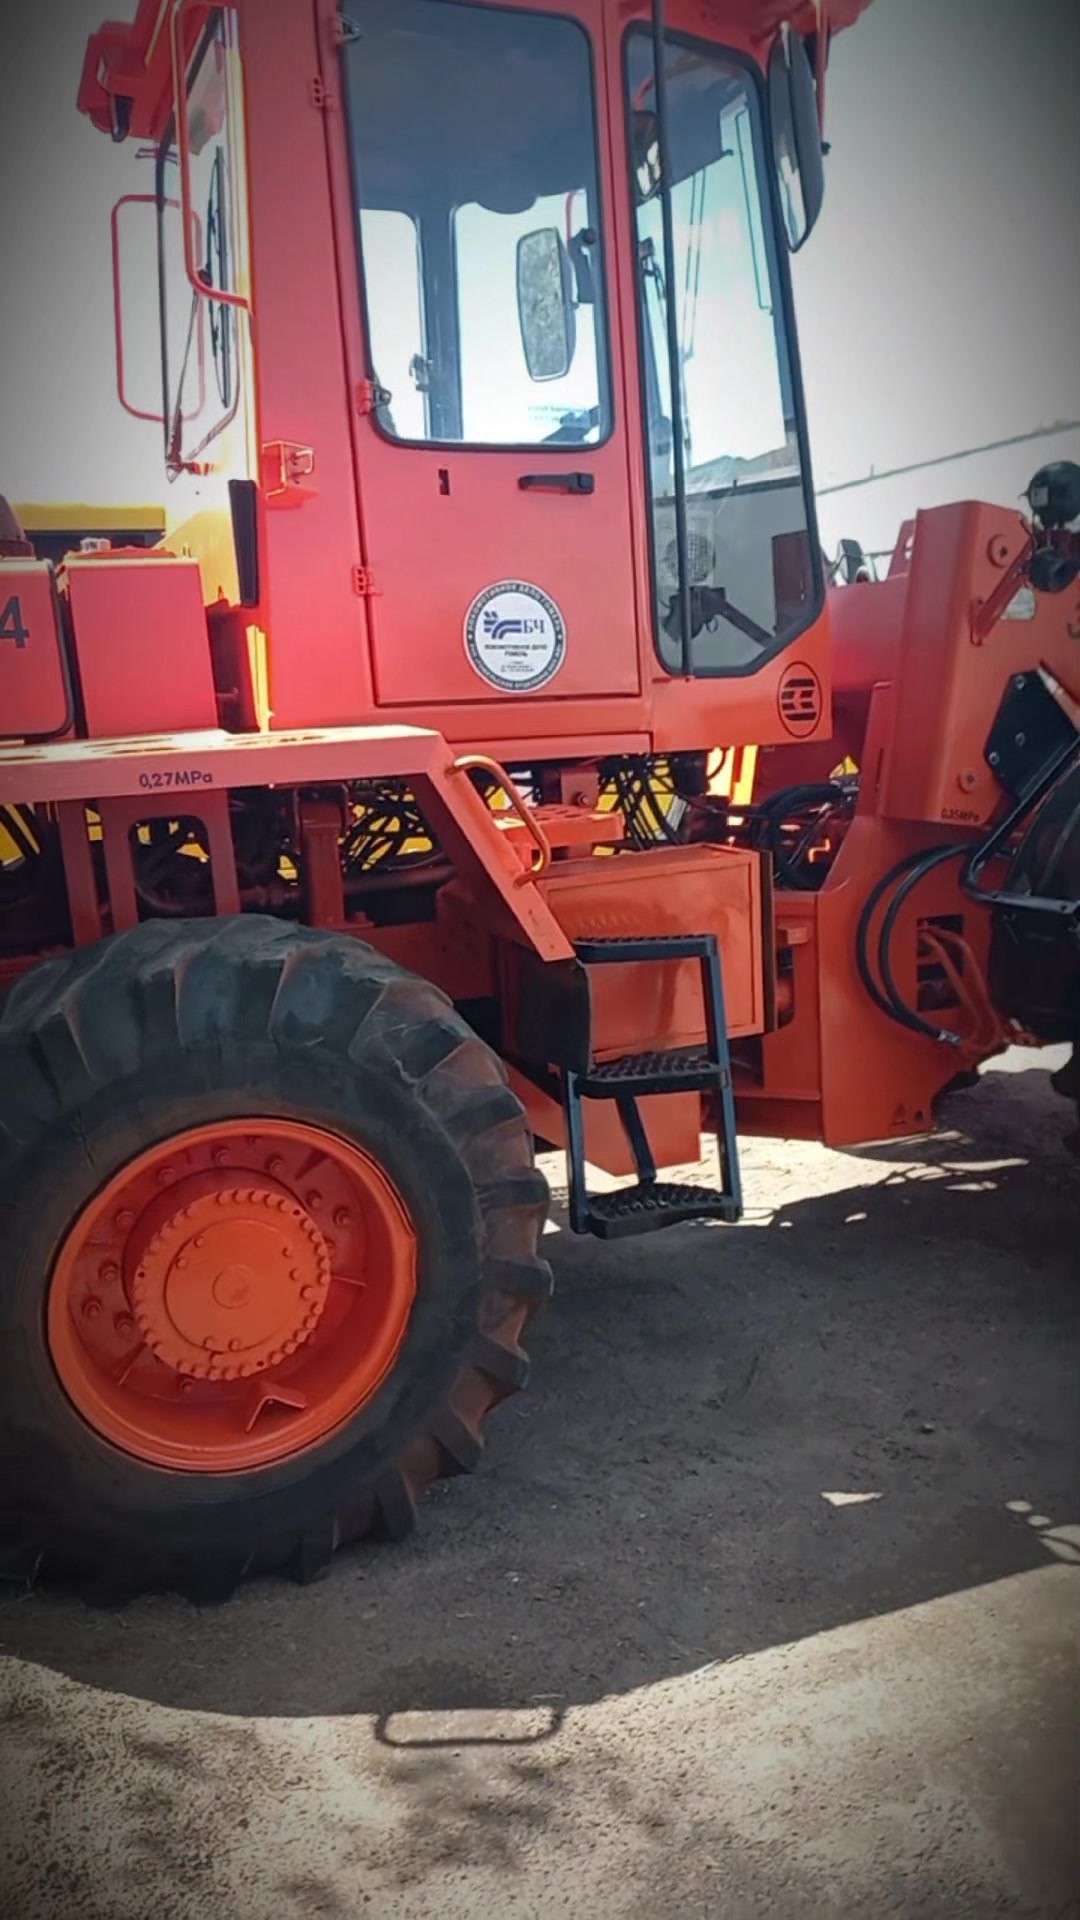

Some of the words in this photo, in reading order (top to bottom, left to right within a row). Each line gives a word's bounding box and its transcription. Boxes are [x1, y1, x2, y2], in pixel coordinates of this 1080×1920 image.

[0, 596, 29, 648] 4
[523, 619, 545, 633] БЧ
[138, 770, 213, 789] 0,27MPa
